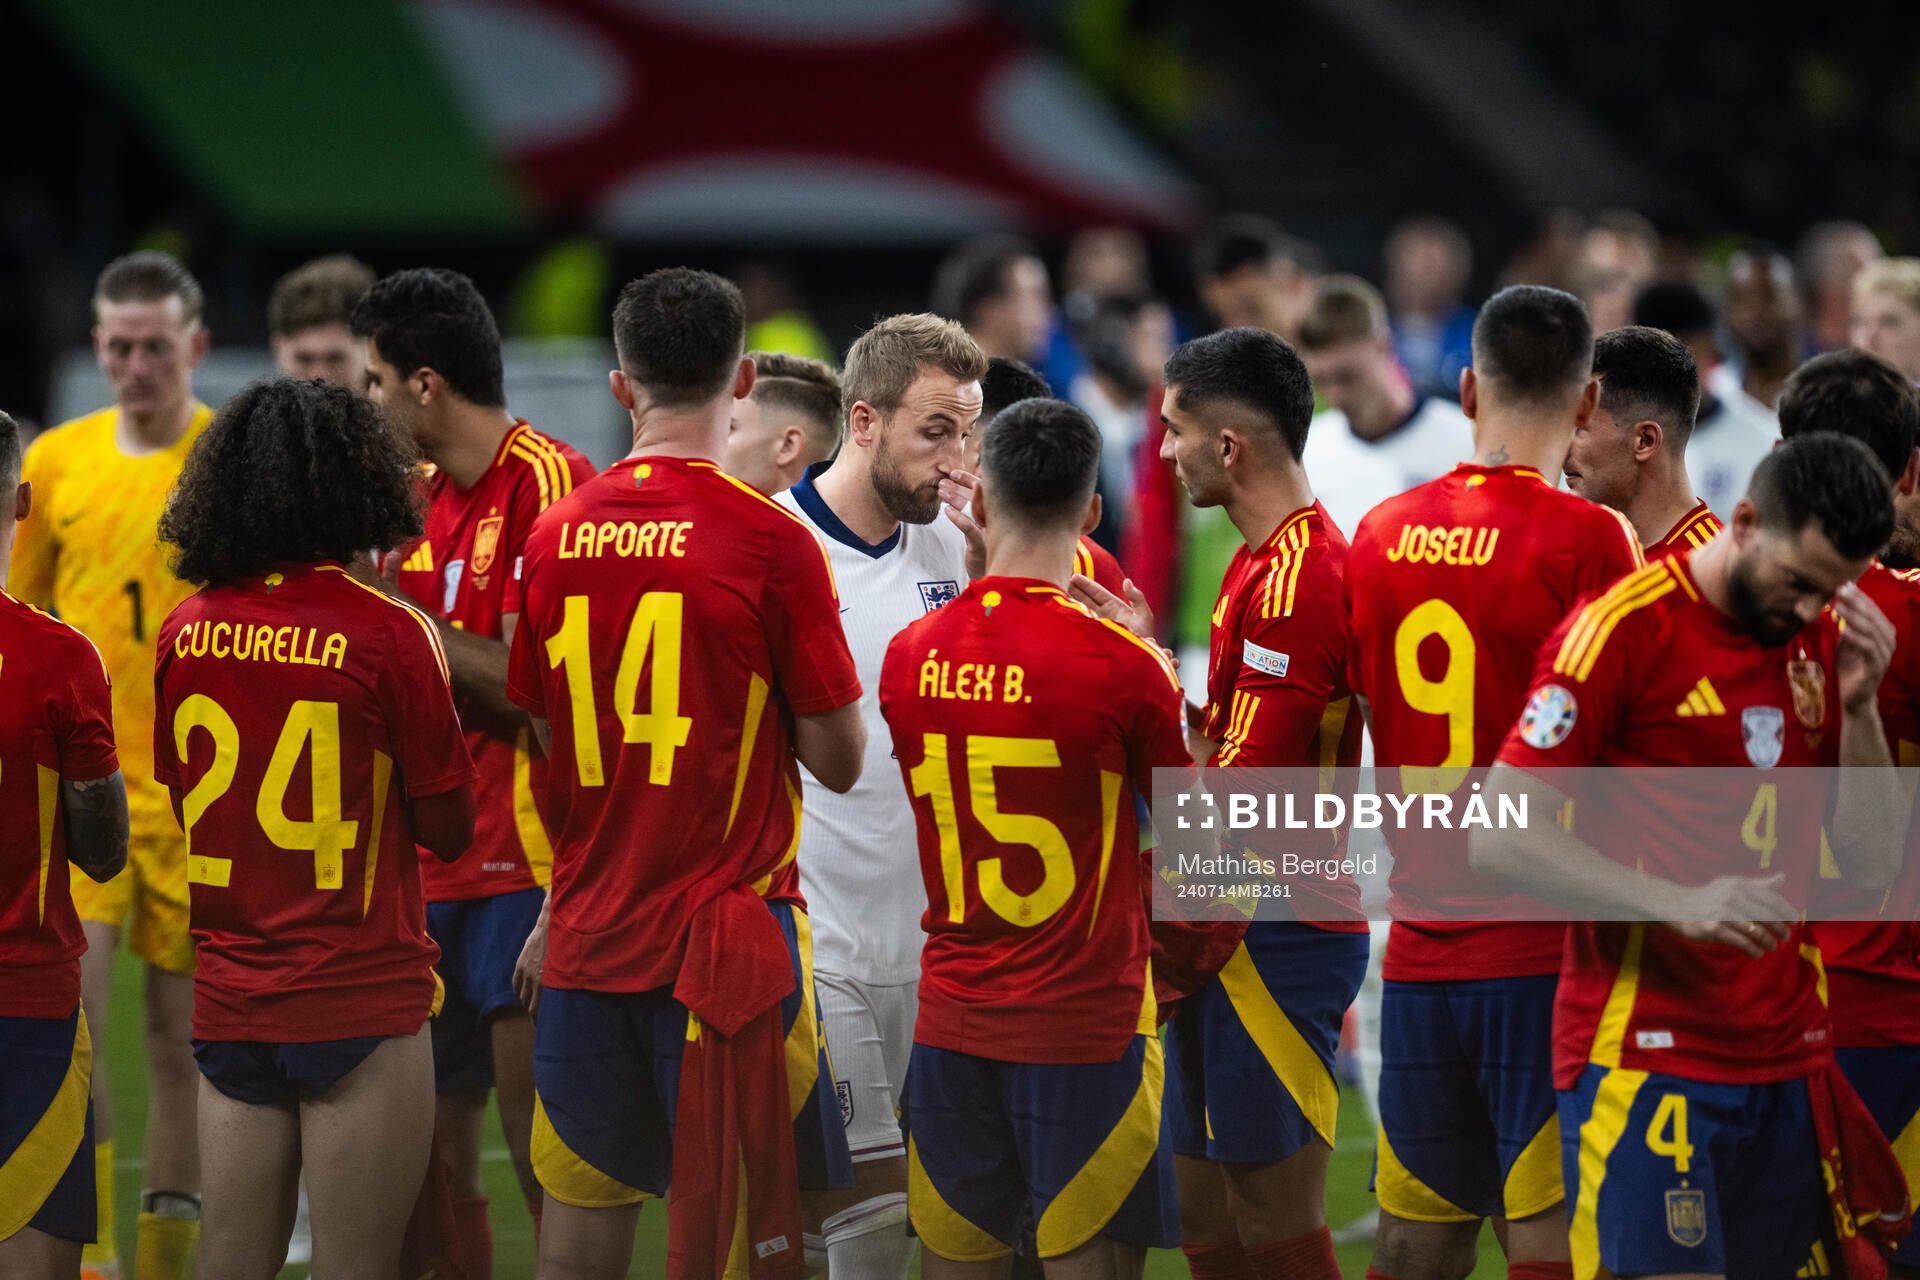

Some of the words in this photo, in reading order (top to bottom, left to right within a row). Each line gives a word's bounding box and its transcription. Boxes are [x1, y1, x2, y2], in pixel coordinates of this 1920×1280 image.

[558, 521, 693, 559] LAPORTE
[1387, 525, 1499, 566] JOSELU
[122, 580, 144, 643] 1
[174, 620, 348, 669] CUCURELLA
[545, 592, 692, 787] 14
[919, 649, 993, 701] ÁLEX
[1003, 665, 1032, 704] B.
[1395, 598, 1476, 794] 9
[173, 693, 358, 889] 24
[910, 733, 1076, 928] 15
[1741, 783, 1778, 870] 4
[1645, 1093, 1694, 1173] 4
